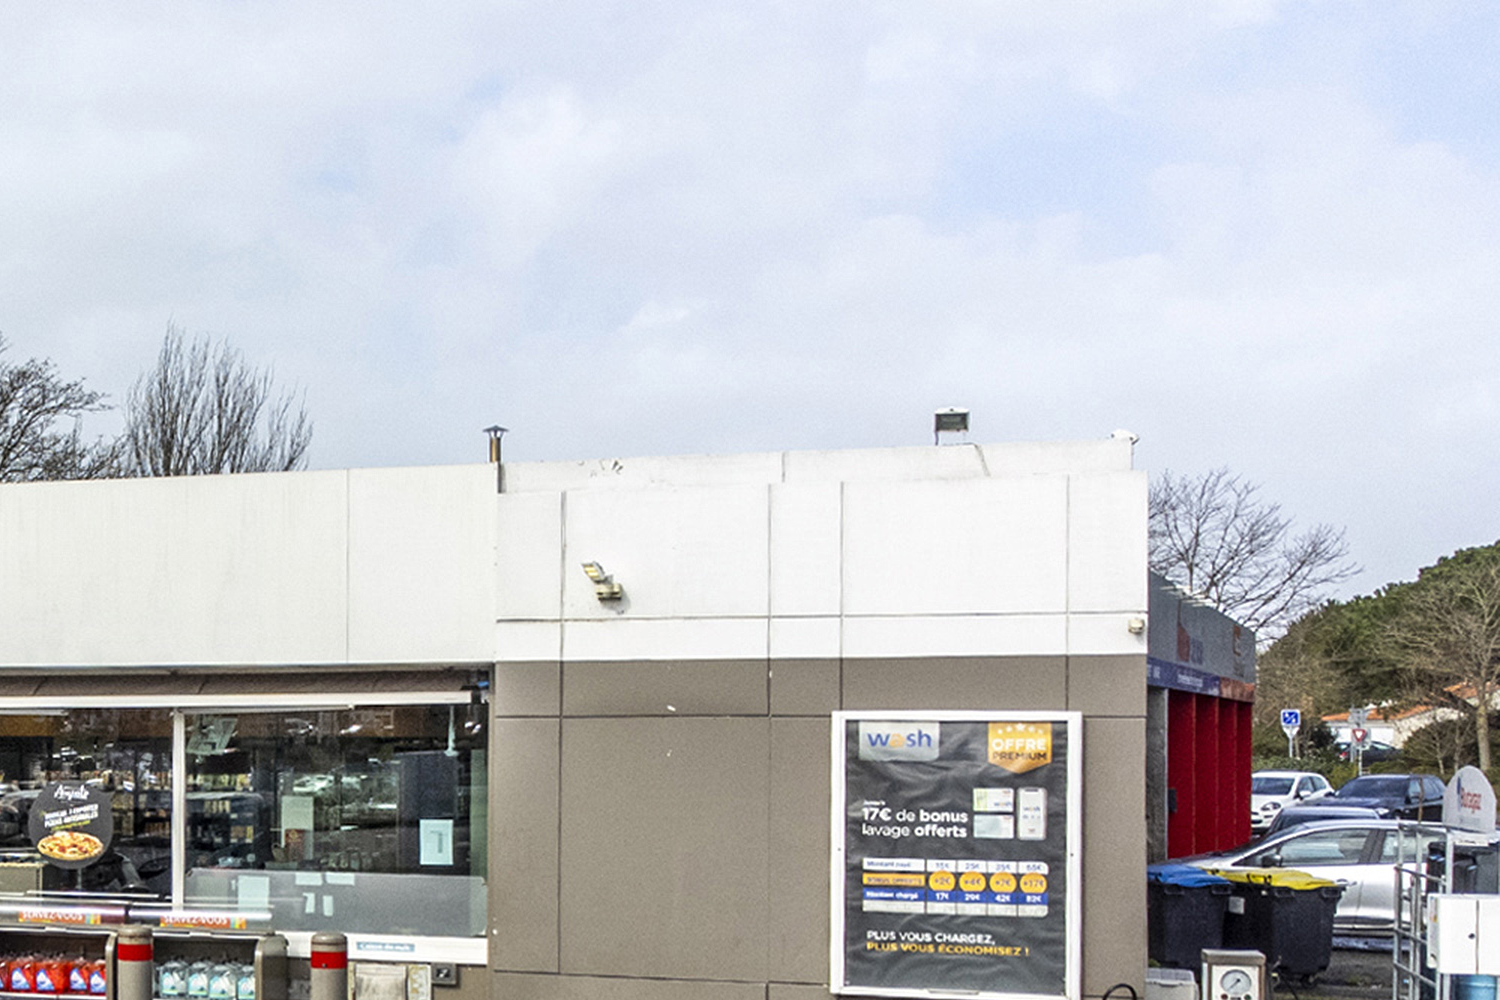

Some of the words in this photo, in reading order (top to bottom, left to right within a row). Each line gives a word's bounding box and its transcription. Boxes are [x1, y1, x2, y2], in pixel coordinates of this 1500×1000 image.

[867, 729, 932, 749] wash
[991, 737, 1047, 751] OFFRE
[992, 751, 1047, 761] PREMIUM
[862, 807, 892, 821] 17€
[895, 809, 916, 822] de
[919, 809, 968, 823] bonus
[862, 823, 910, 838] lavage
[914, 825, 968, 838] offerts
[935, 891, 950, 900] 17€
[995, 893, 1011, 902] 42€
[867, 931, 896, 941] PLUS
[899, 932, 932, 942] VOUS
[934, 933, 996, 945] CHARGEZ,
[866, 942, 898, 952] PLUS
[901, 944, 936, 954] VOUS
[939, 943, 1022, 956] ÉCONOMISEZ
